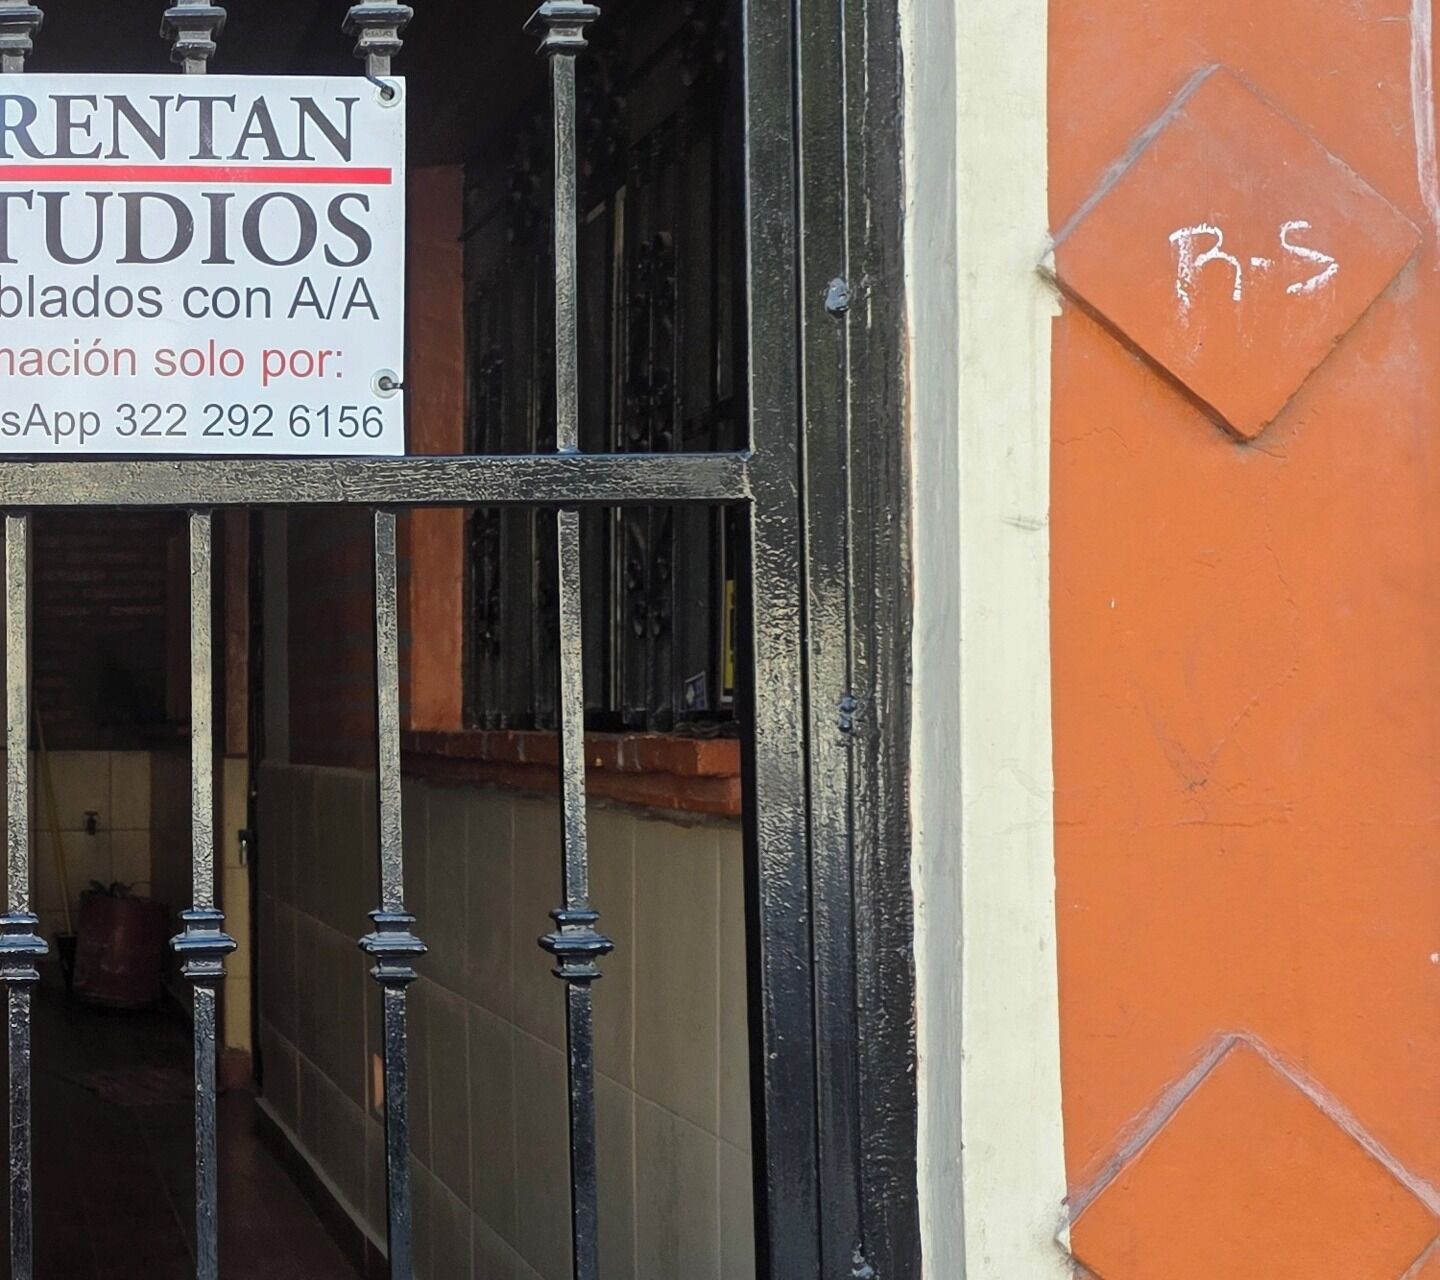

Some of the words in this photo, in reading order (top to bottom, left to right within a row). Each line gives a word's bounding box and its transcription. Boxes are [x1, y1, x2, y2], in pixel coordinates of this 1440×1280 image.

[182, 284, 271, 319] con
[288, 275, 380, 320] A/A
[154, 338, 245, 378] solo
[262, 345, 343, 387] por:
[115, 403, 187, 437] 322
[202, 403, 274, 438] 292
[289, 404, 384, 439] 6156
